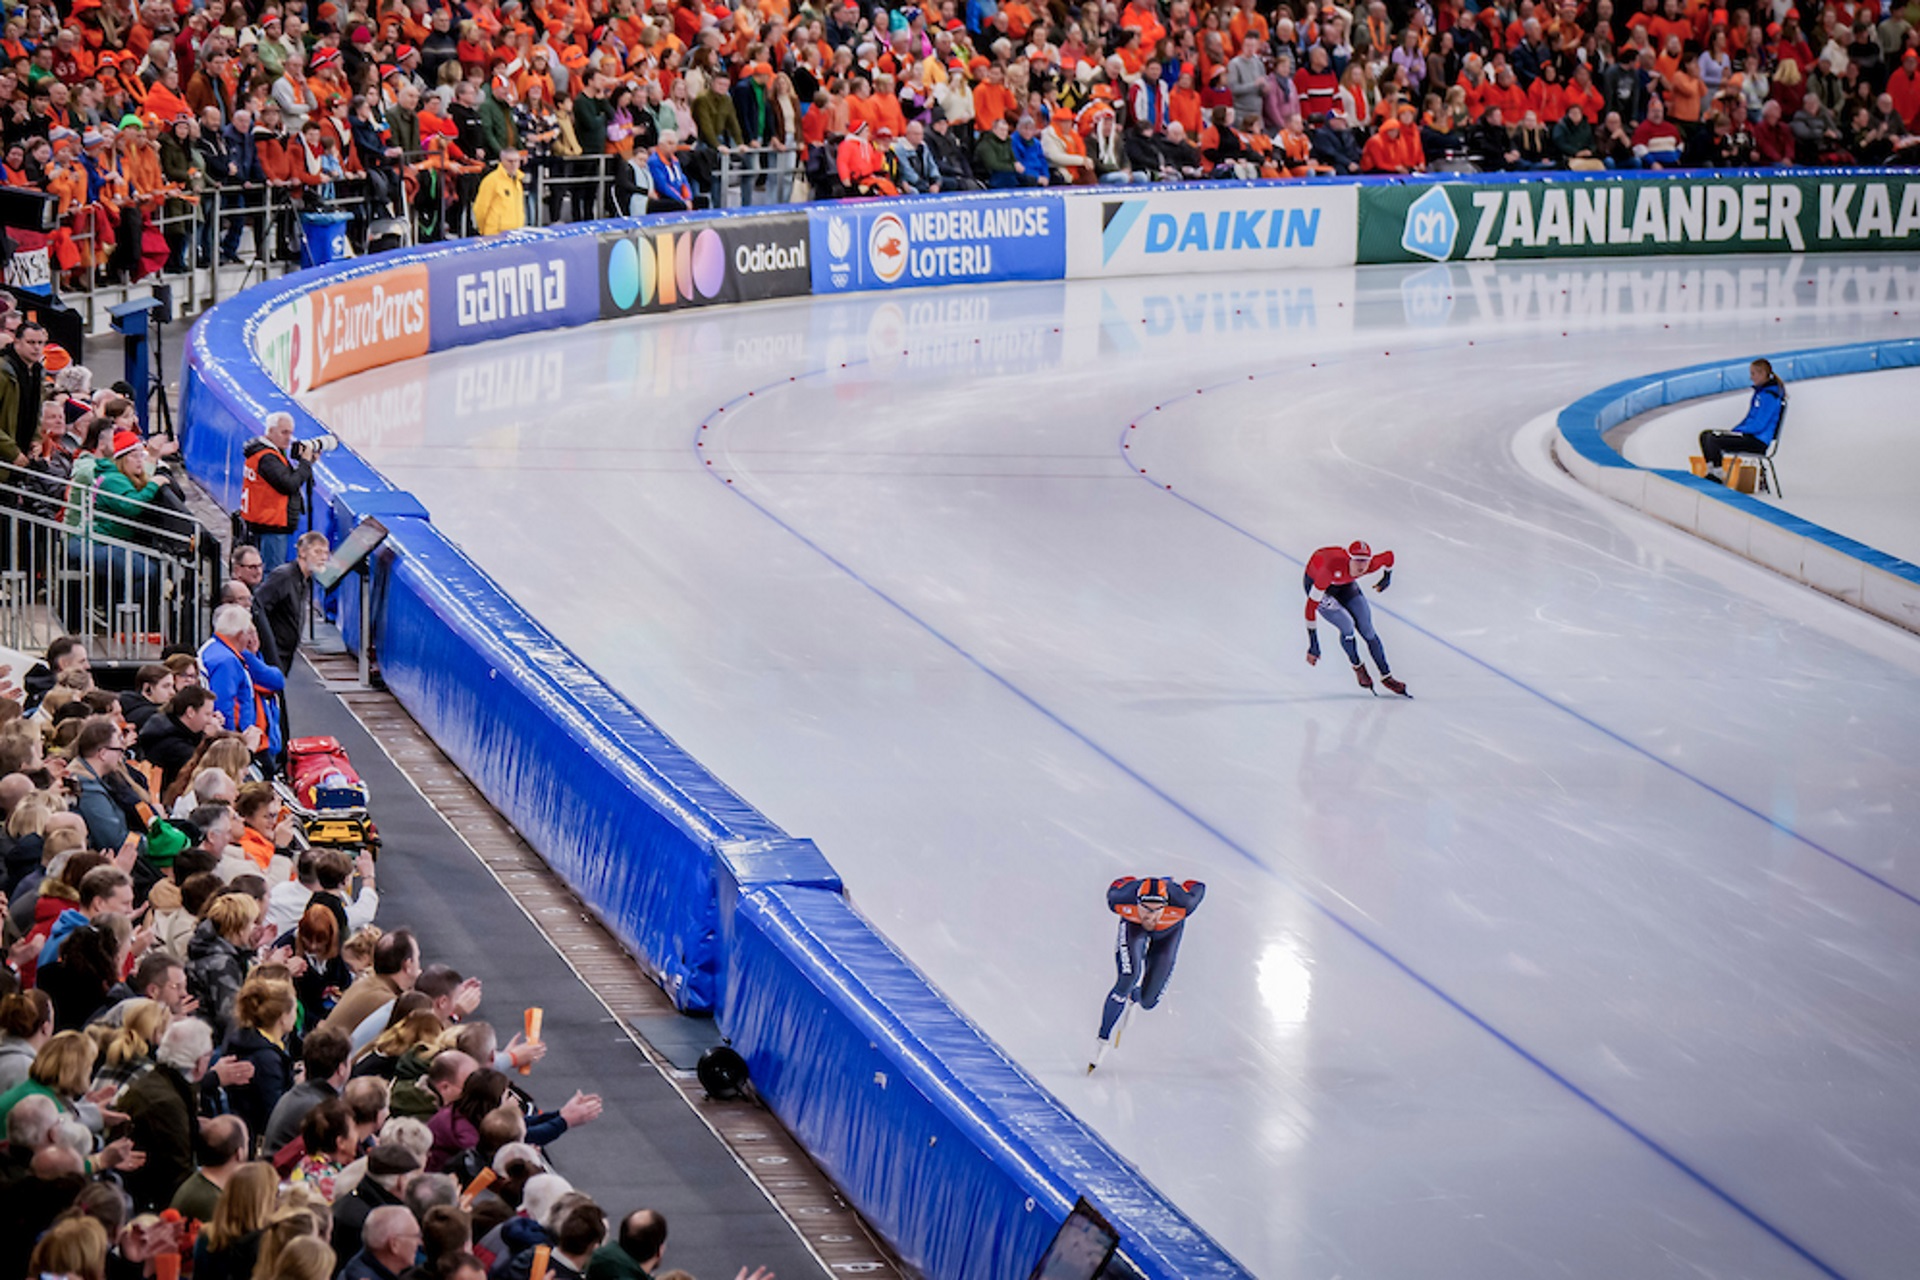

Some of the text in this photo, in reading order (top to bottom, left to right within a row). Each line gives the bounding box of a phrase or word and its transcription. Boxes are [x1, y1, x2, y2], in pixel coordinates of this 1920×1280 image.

[909, 206, 1049, 243] NEDERLANDSE
[1145, 207, 1321, 254] DAIKIN
[1466, 182, 1920, 259] ZAANLANDER KAA
[735, 239, 806, 275] Odido.nl
[909, 246, 991, 279] LOTERIJ
[333, 284, 424, 355] EuroParcs
